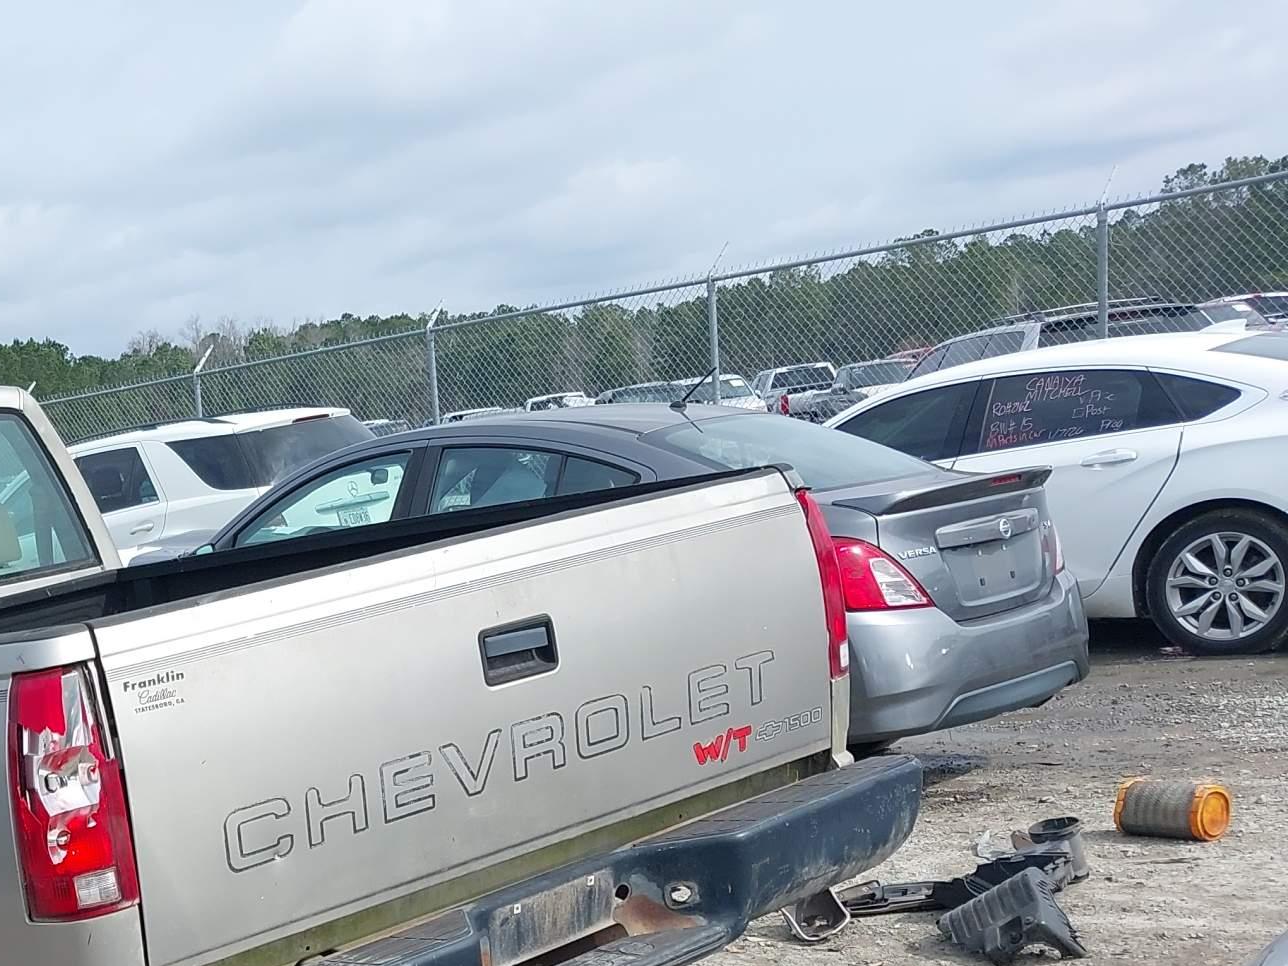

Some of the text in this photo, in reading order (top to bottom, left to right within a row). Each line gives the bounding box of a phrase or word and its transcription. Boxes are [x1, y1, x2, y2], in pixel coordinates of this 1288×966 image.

[898, 546, 937, 560] VERSA
[123, 670, 185, 692] Franklin
[137, 687, 177, 706] Cadillac
[692, 706, 823, 765] W/T 1500
[224, 649, 775, 874] CHEVROLET
